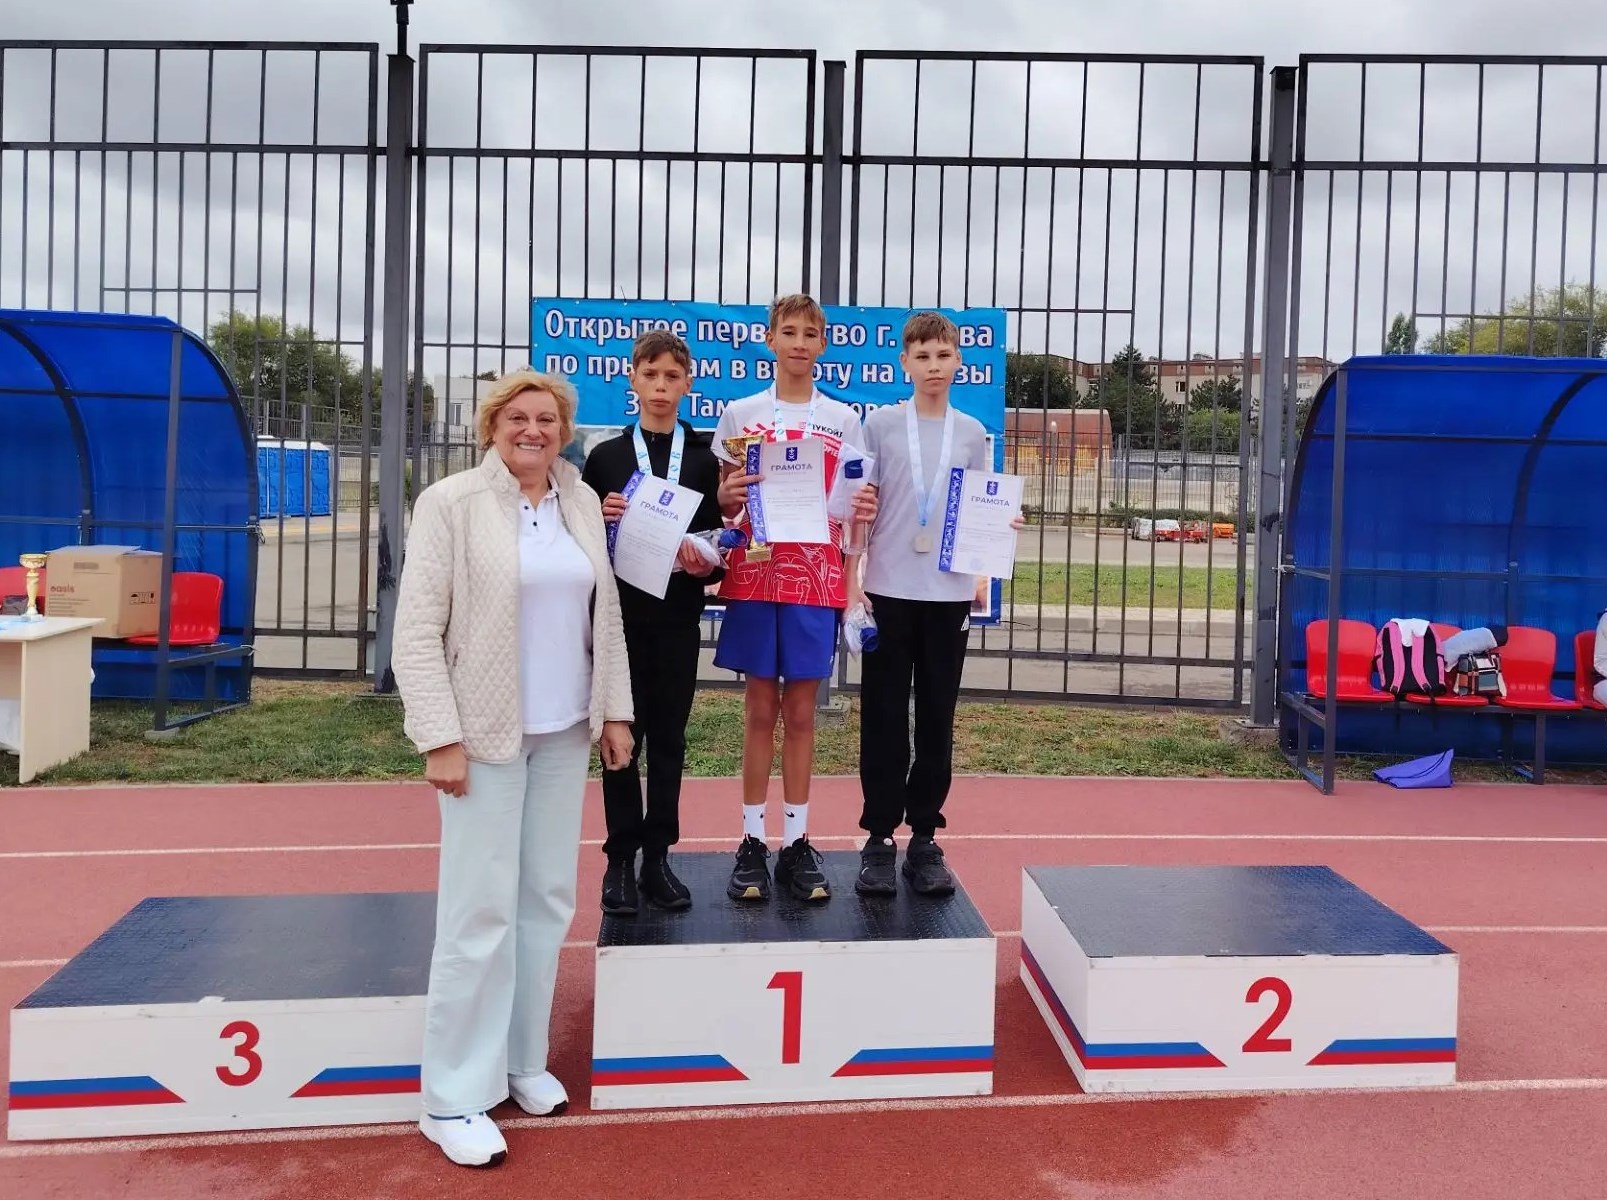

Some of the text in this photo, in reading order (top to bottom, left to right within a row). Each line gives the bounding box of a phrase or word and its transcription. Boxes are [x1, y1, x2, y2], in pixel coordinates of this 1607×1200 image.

[544, 308, 896, 349] Открытое первво г.
[545, 354, 578, 375] по
[587, 356, 720, 382] прыам
[731, 359, 746, 379] в
[756, 360, 852, 389] воту
[861, 363, 894, 383] на
[770, 463, 813, 472] ГРАМОТА
[640, 501, 679, 521] ГРАМОТА
[971, 495, 1010, 507] ГРАМОТА
[769, 972, 801, 1063] 1
[1244, 977, 1291, 1052] 2
[218, 1022, 261, 1085] 3
